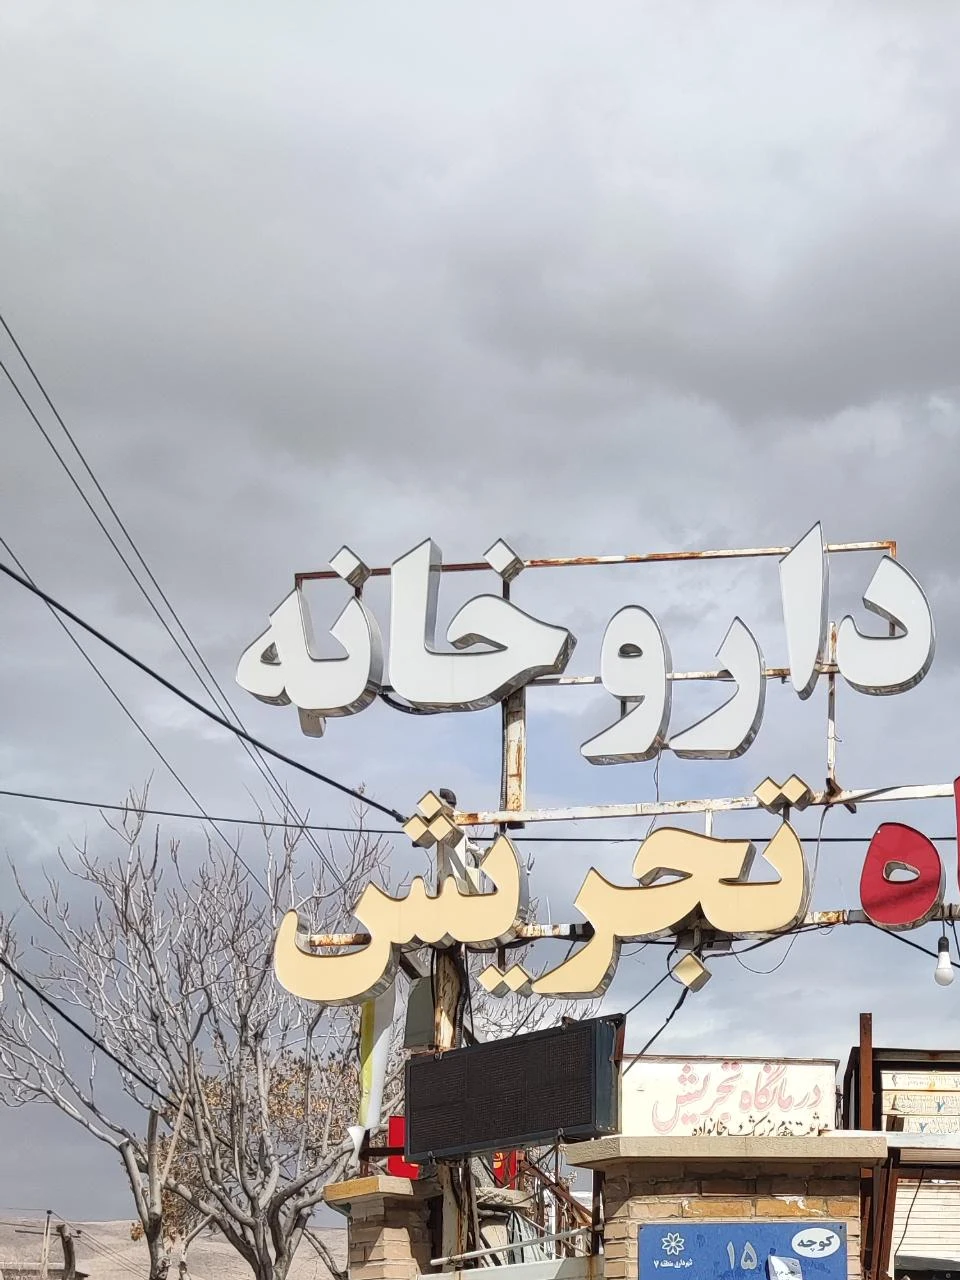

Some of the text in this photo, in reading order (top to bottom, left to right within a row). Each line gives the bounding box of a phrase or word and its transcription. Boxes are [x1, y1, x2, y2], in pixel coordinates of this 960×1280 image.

[235, 520, 936, 766] داروخانه
[273, 774, 812, 1006] تجریش
[652, 1061, 743, 1135] تجریش
[738, 1062, 824, 1113] درمانگاه
[674, 1257, 693, 1269] شهرداری
[726, 1241, 758, 1270] ۱۵
[796, 1234, 835, 1252] کوچه
